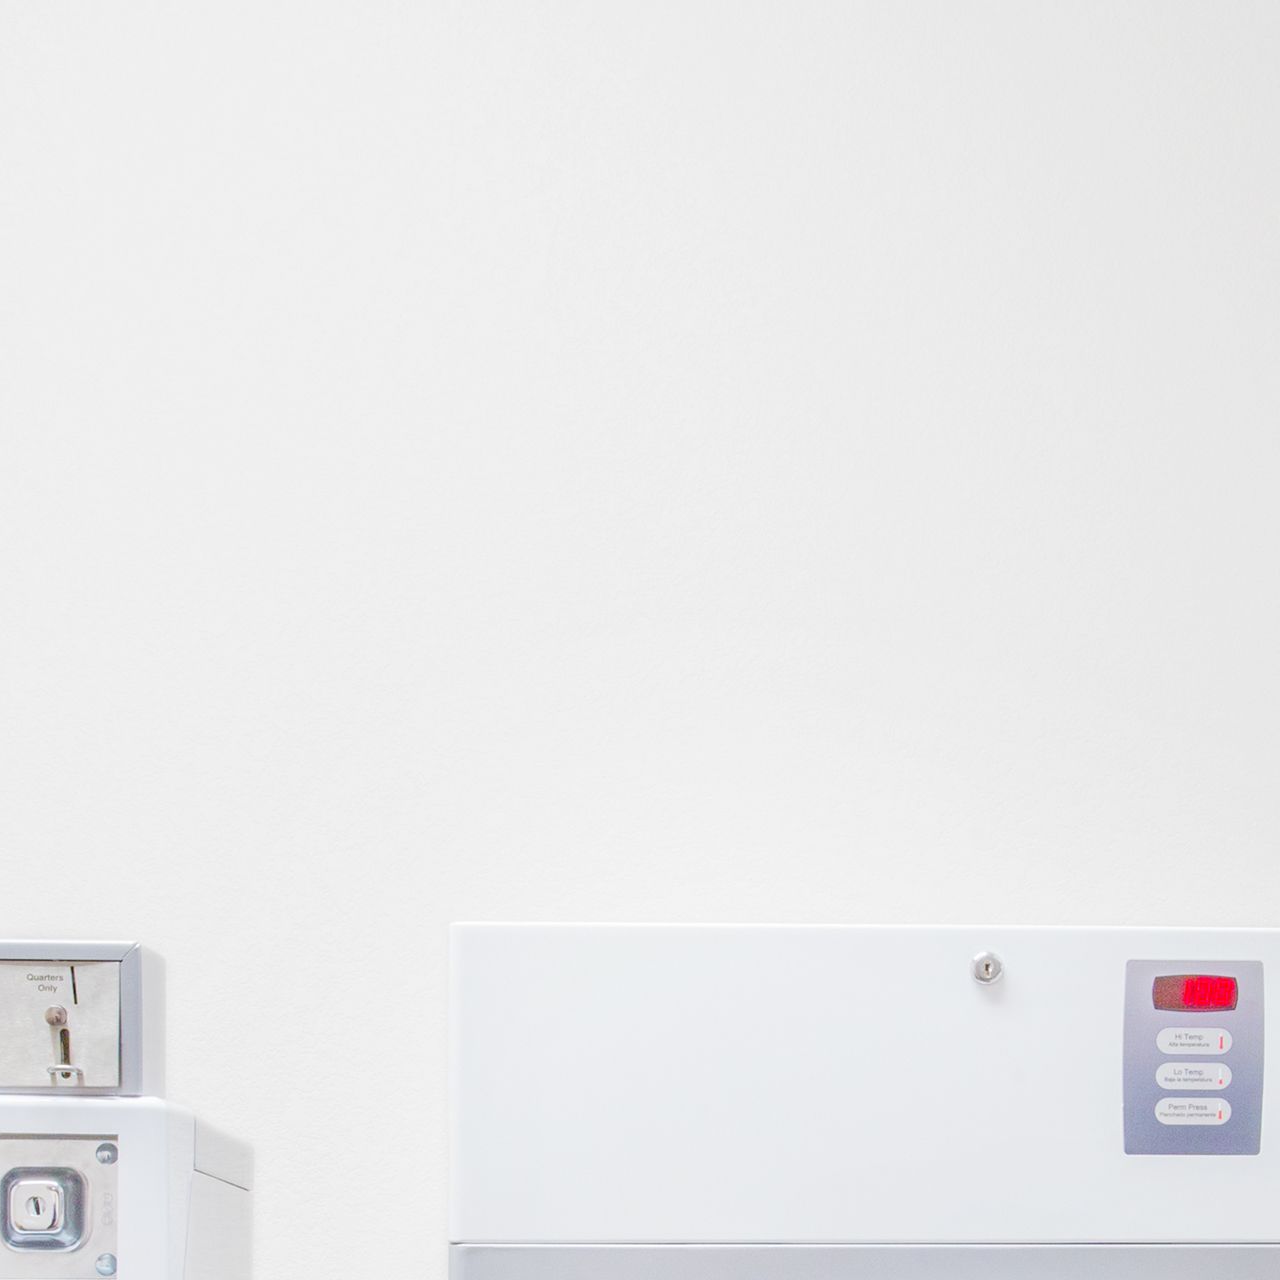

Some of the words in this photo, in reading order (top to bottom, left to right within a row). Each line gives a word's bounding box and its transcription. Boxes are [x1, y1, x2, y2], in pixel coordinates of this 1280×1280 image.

[26, 973, 64, 982] Quarters
[37, 984, 58, 993] Only
[1184, 1033, 1204, 1042] Temp
[1173, 1068, 1182, 1076] Lo
[1184, 1068, 1204, 1077] Temp
[1168, 1103, 1187, 1111] Perm
